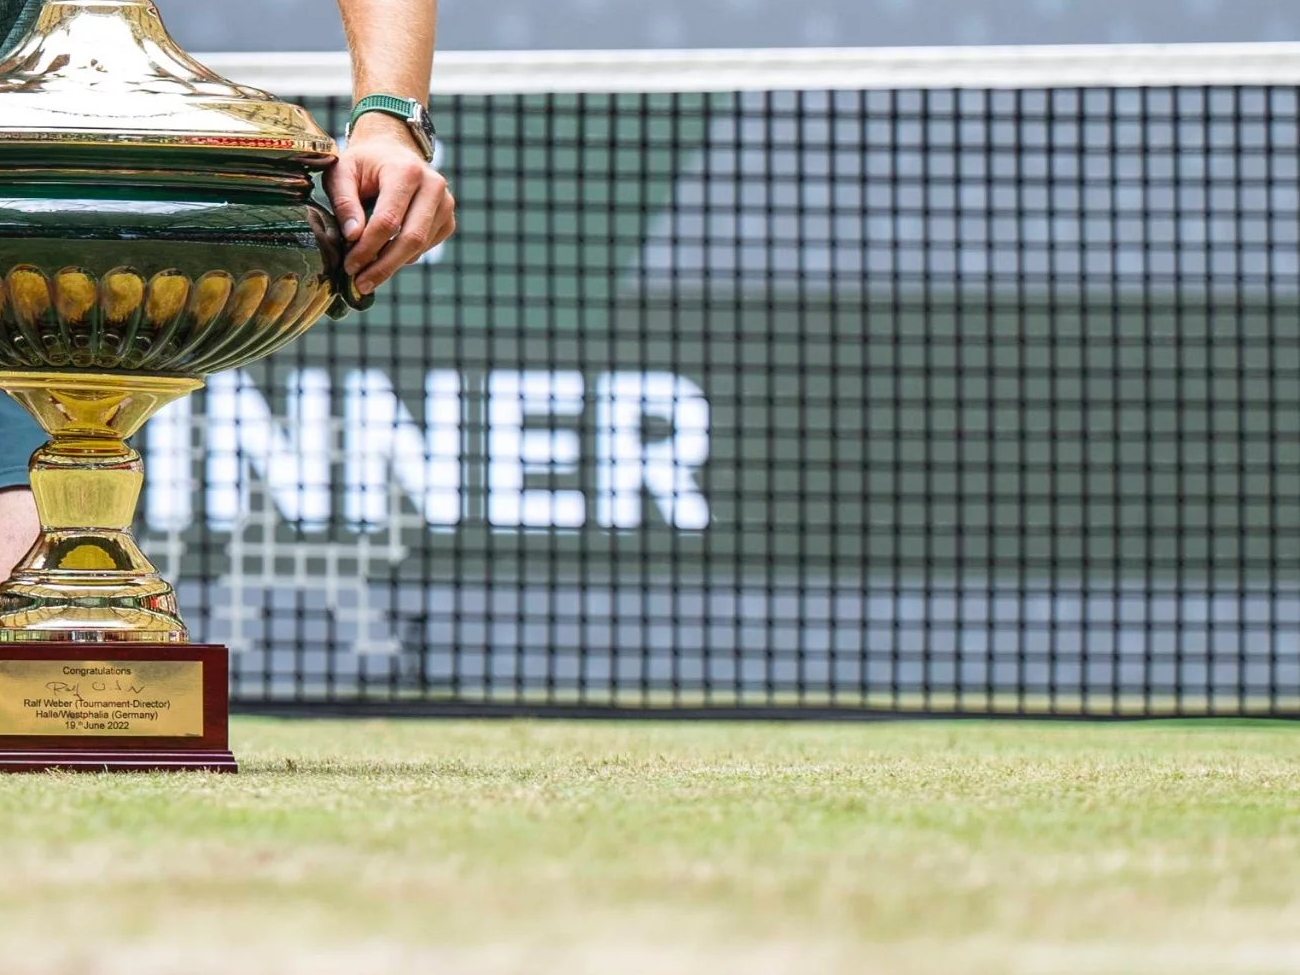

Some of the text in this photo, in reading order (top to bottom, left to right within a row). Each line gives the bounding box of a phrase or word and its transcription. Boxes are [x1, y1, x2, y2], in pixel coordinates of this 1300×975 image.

[145, 368, 710, 529] INNER
[62, 666, 132, 677] Congratulations
[23, 698, 171, 710] Ralf Weber (Tournament-Director)
[35, 710, 159, 721] Halle/Westphalia (Germany)
[84, 721, 105, 730] June
[108, 721, 130, 730] 2022
